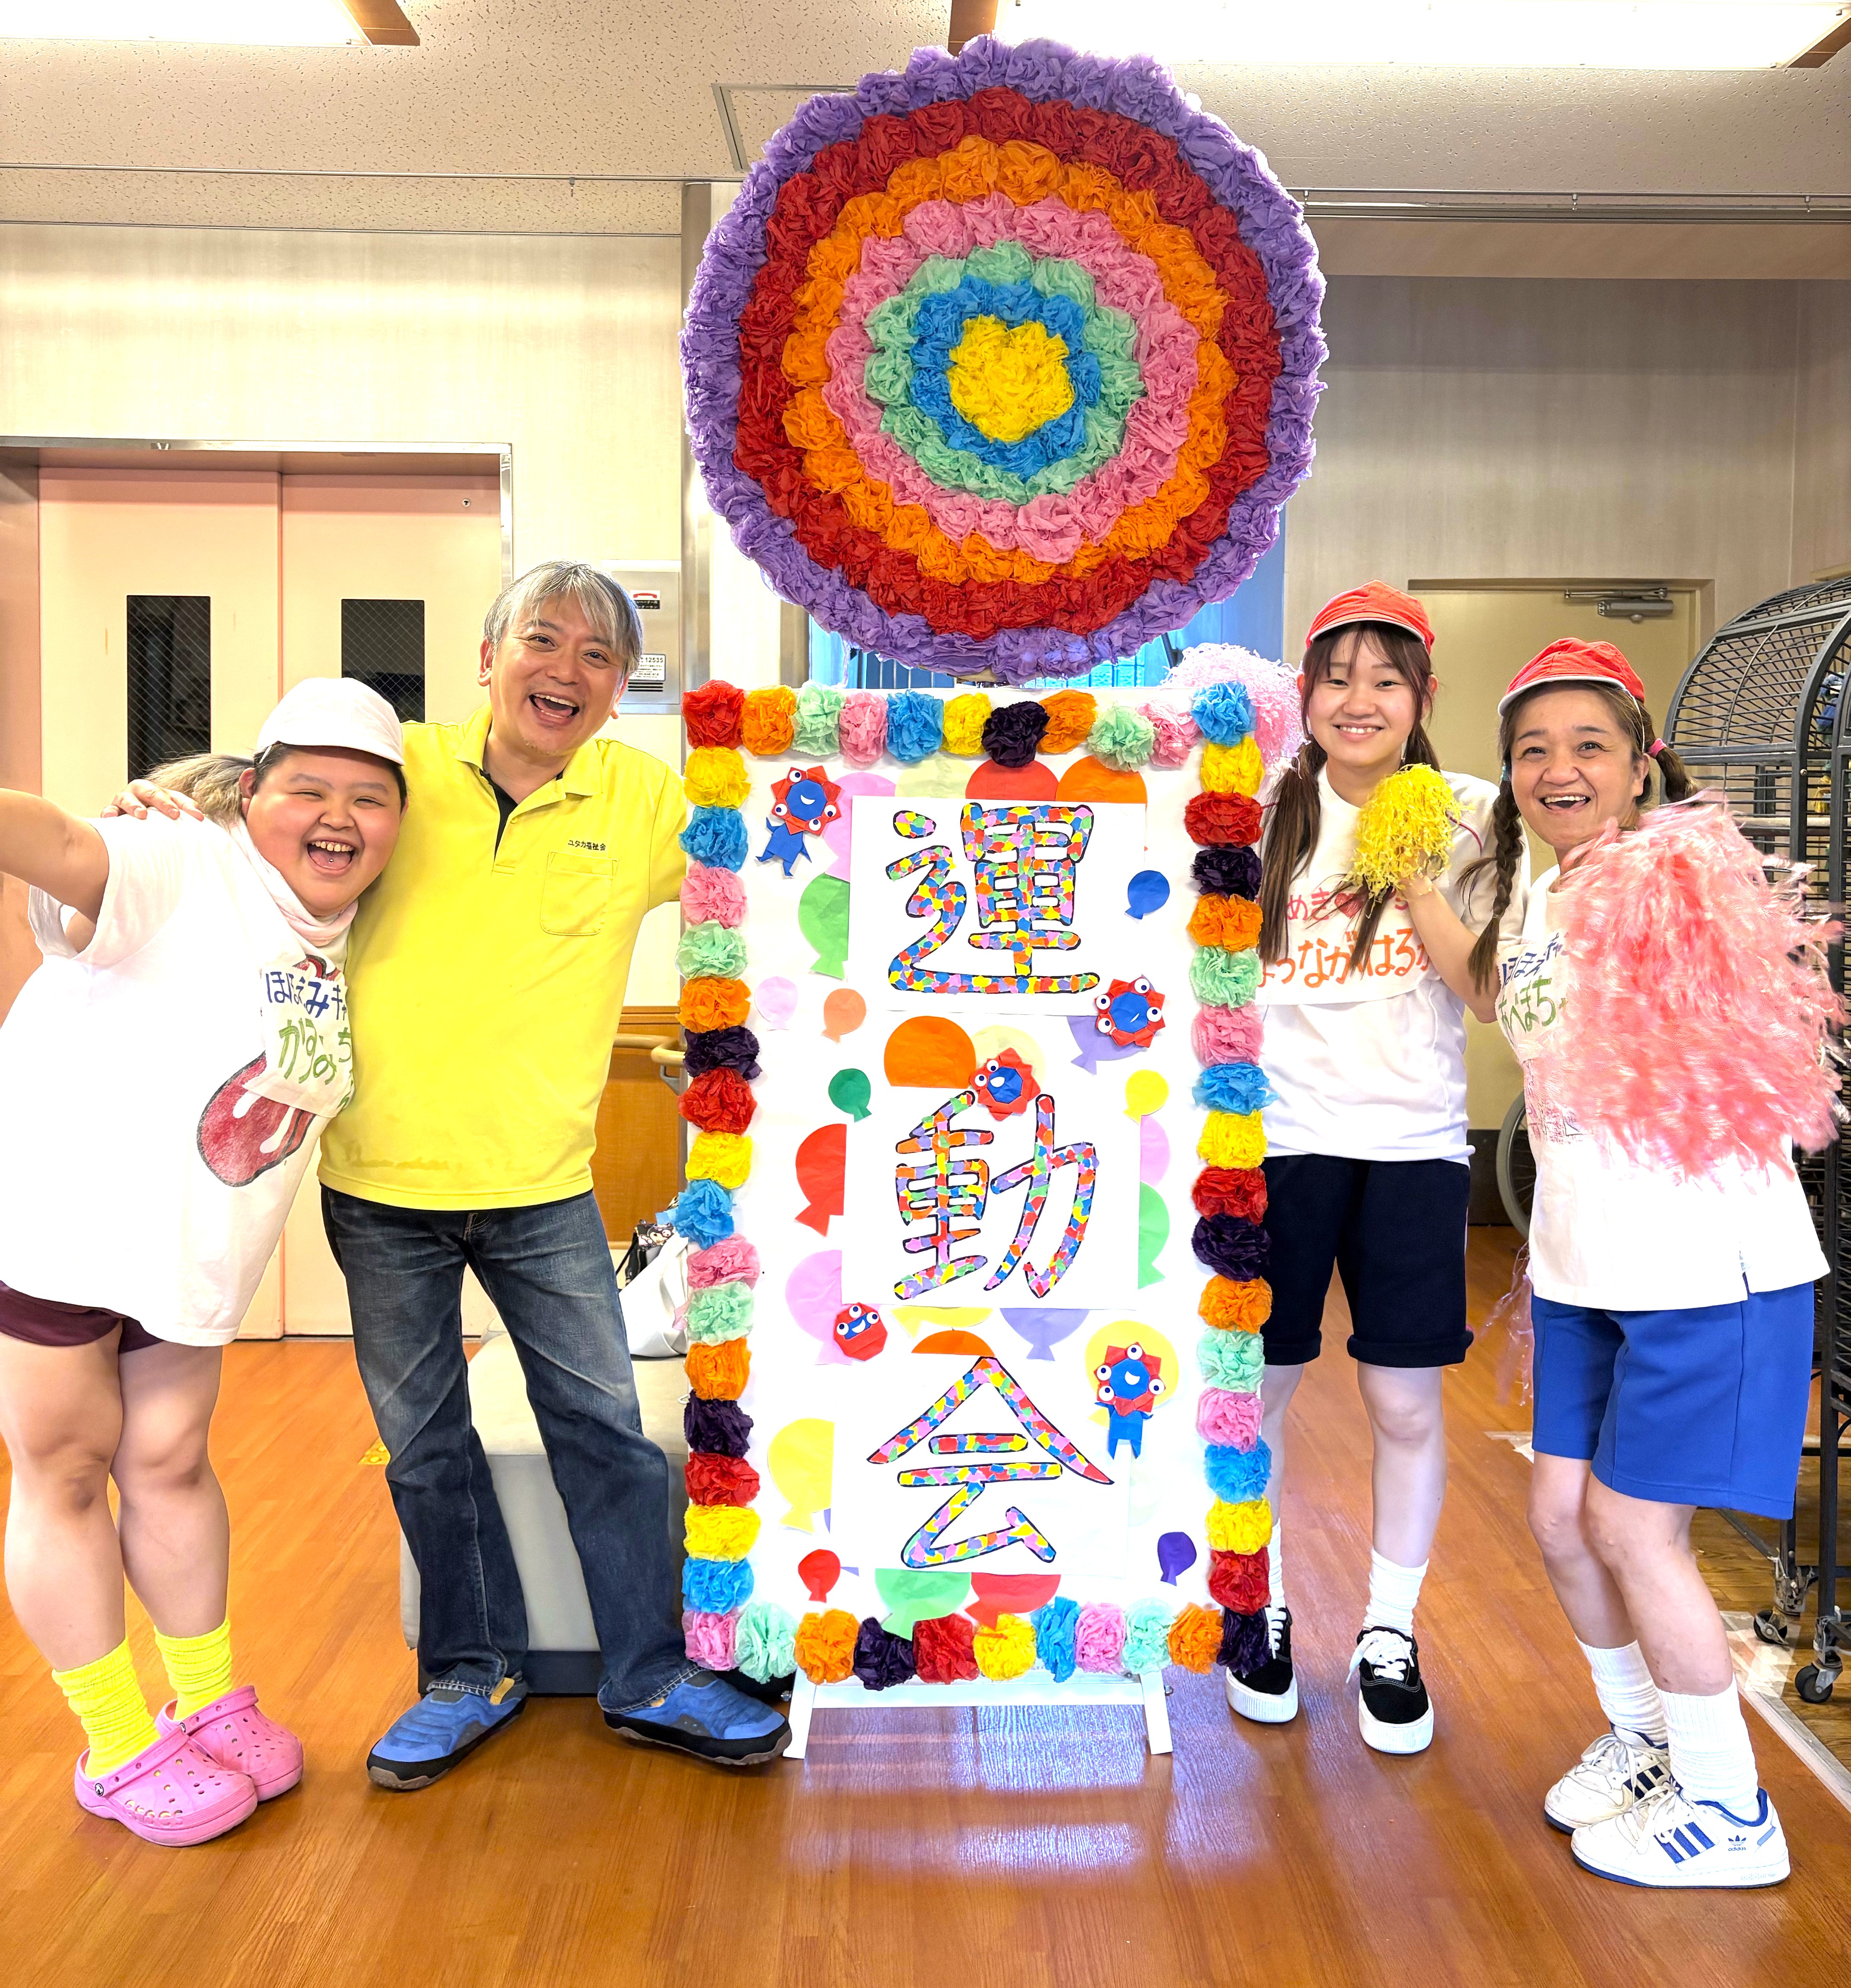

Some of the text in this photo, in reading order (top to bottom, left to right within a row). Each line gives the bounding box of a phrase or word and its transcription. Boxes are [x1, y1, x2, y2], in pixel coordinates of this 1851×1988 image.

[568, 840, 606, 851] ユタカ福祉会
[867, 803, 1113, 1568] 運動会
